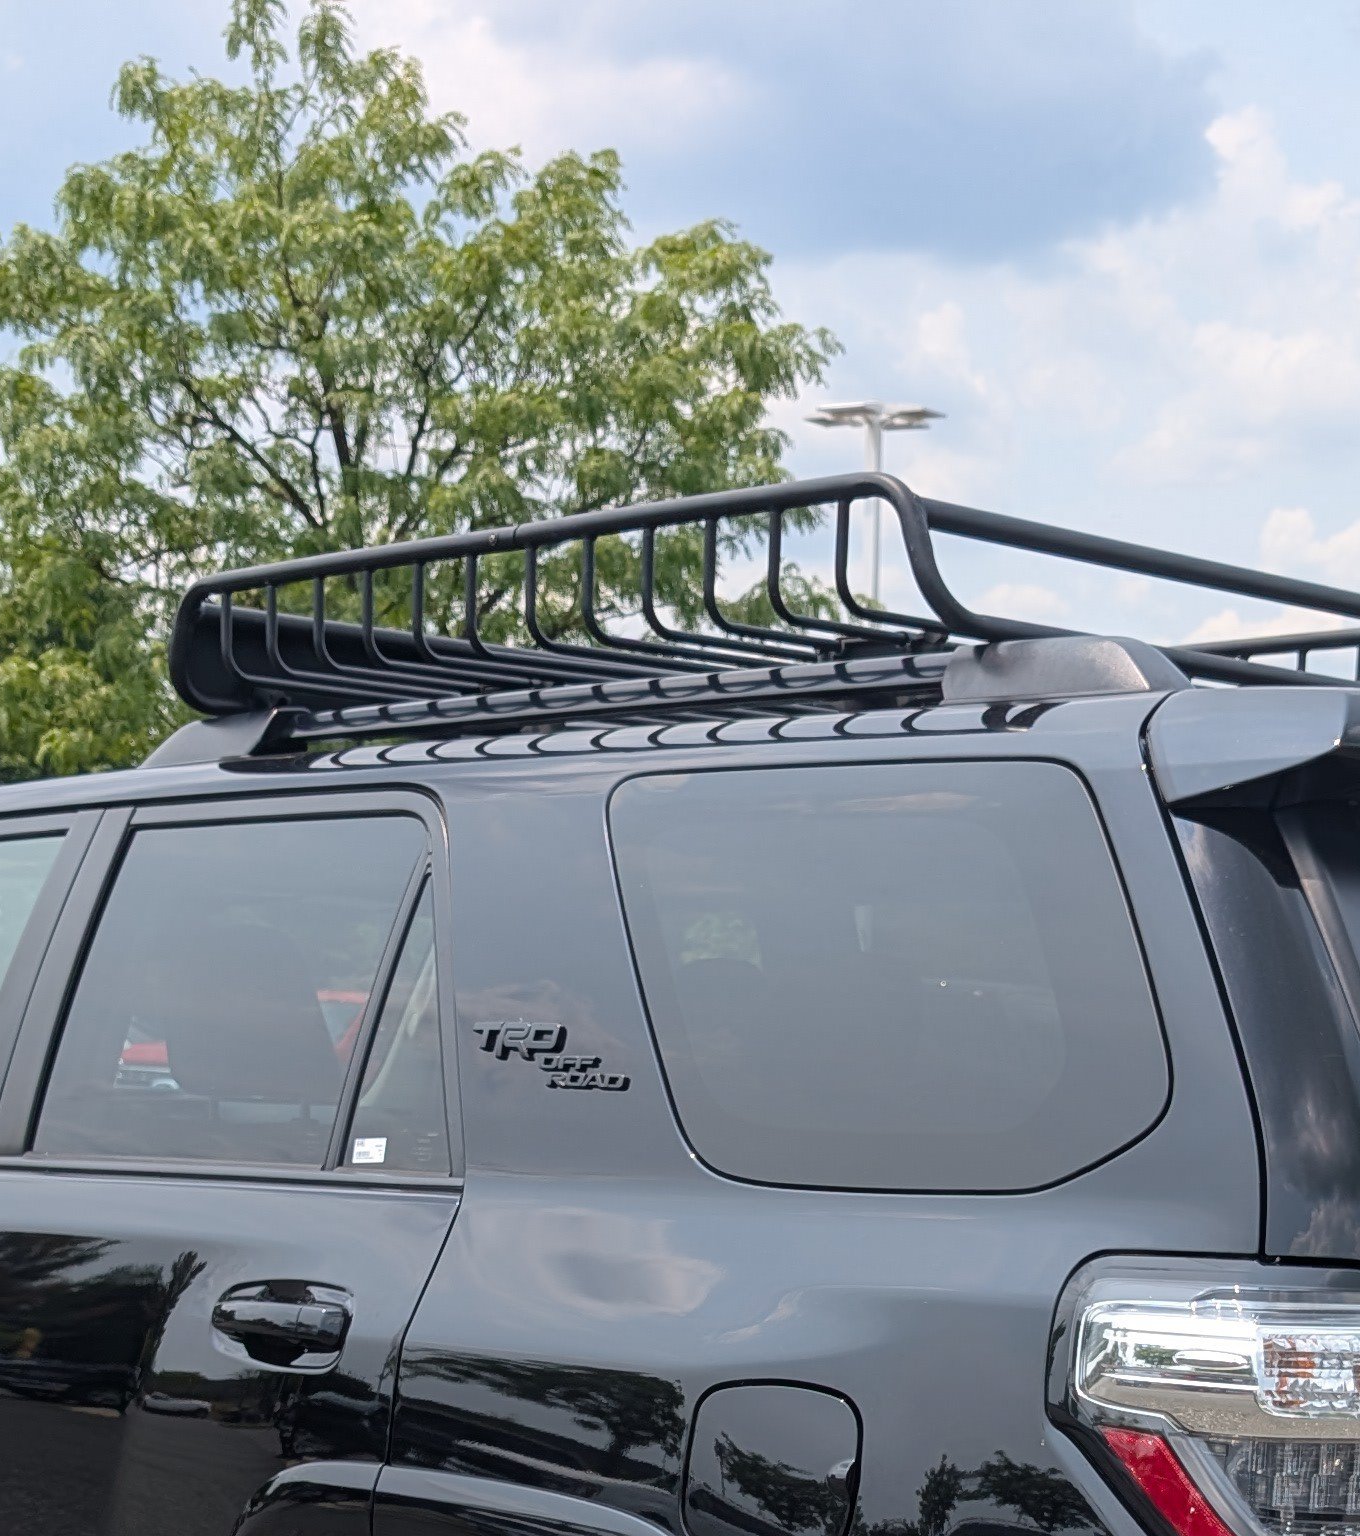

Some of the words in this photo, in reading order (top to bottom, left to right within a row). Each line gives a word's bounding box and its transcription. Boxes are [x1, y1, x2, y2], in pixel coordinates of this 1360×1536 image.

[472, 1020, 568, 1061] TRD
[539, 1054, 602, 1072] OFF
[545, 1073, 632, 1092] ROAD
